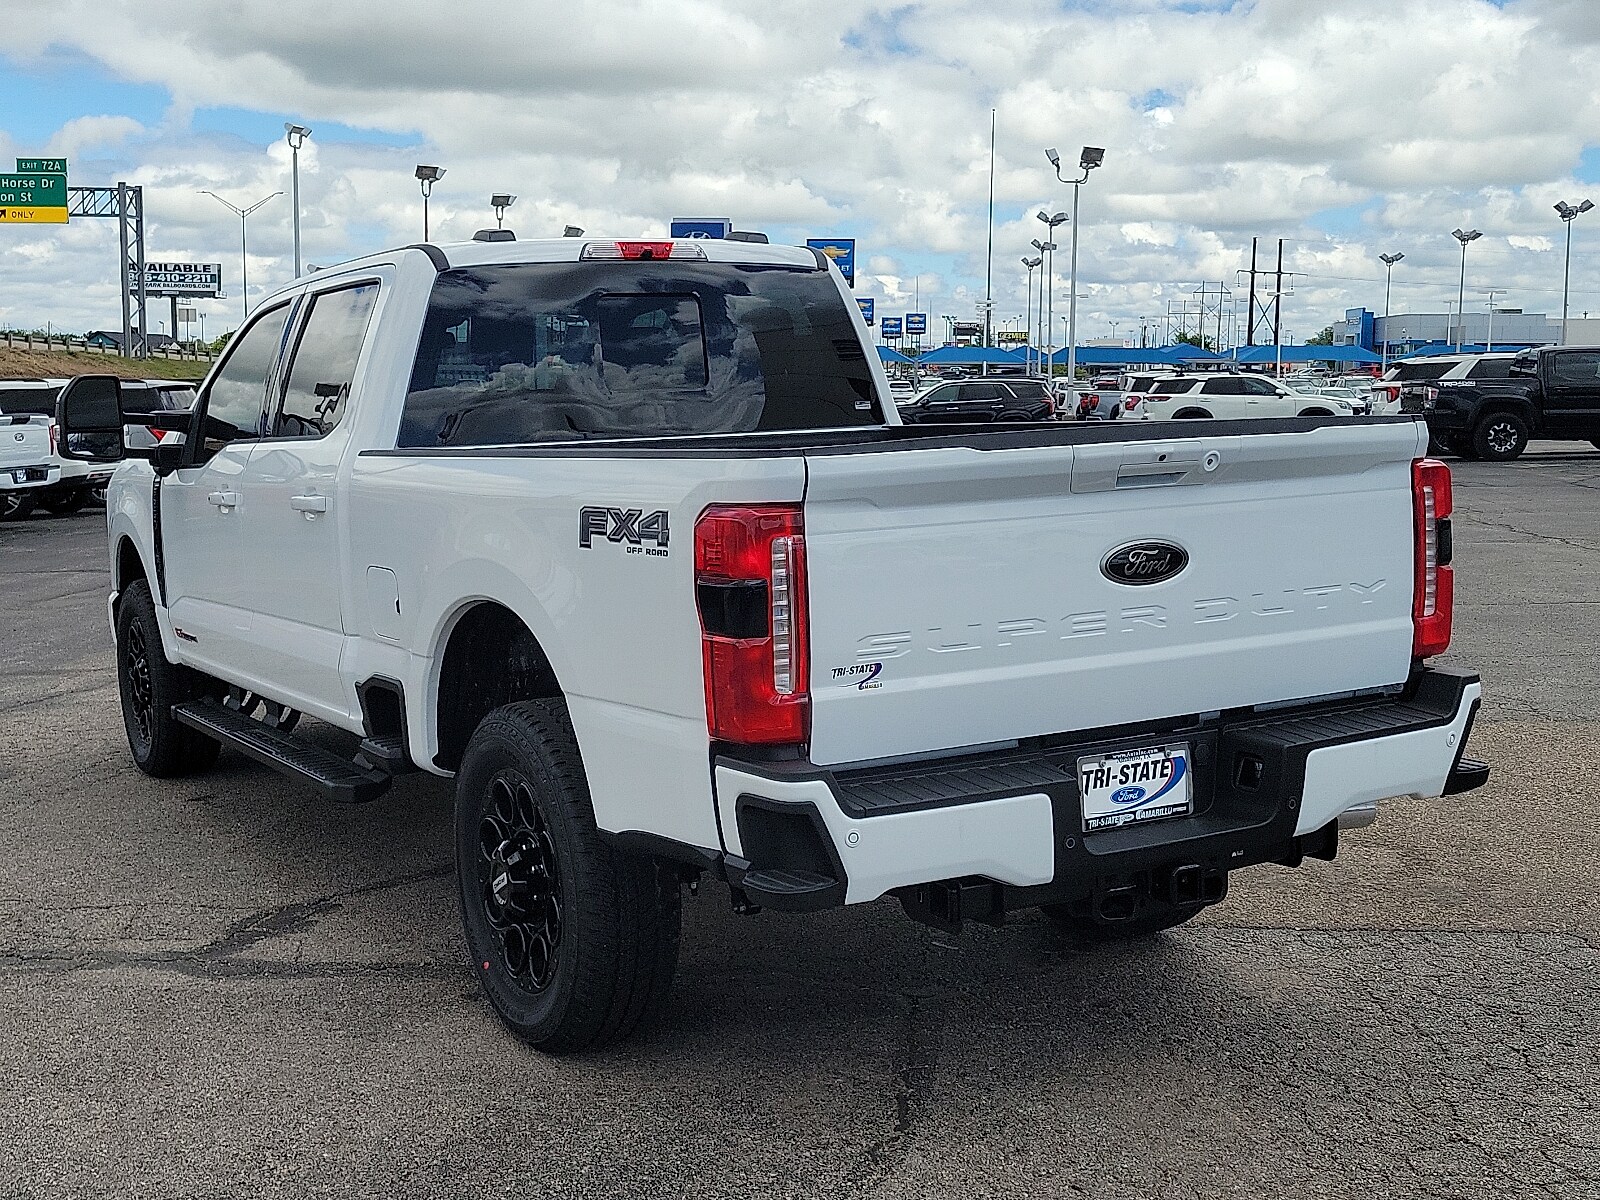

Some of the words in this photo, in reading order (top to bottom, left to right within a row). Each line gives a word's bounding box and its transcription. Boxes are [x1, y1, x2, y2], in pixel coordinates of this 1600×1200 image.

[41, 161, 61, 170] 72A
[1, 178, 36, 188] Horse
[41, 178, 55, 188] Dr
[20, 192, 33, 202] St
[11, 210, 35, 218] ONLY
[128, 263, 211, 273] AAILABLE
[579, 506, 670, 549] FX4
[626, 546, 643, 555] OFF
[645, 548, 669, 557] ROAD
[1124, 549, 1171, 576] Ford
[855, 605, 1167, 662] SUPER
[1193, 578, 1387, 624] DUTY
[831, 663, 874, 679] TRI-STATE
[1082, 758, 1171, 797] TRI-STATE
[1117, 789, 1139, 802] Ford
